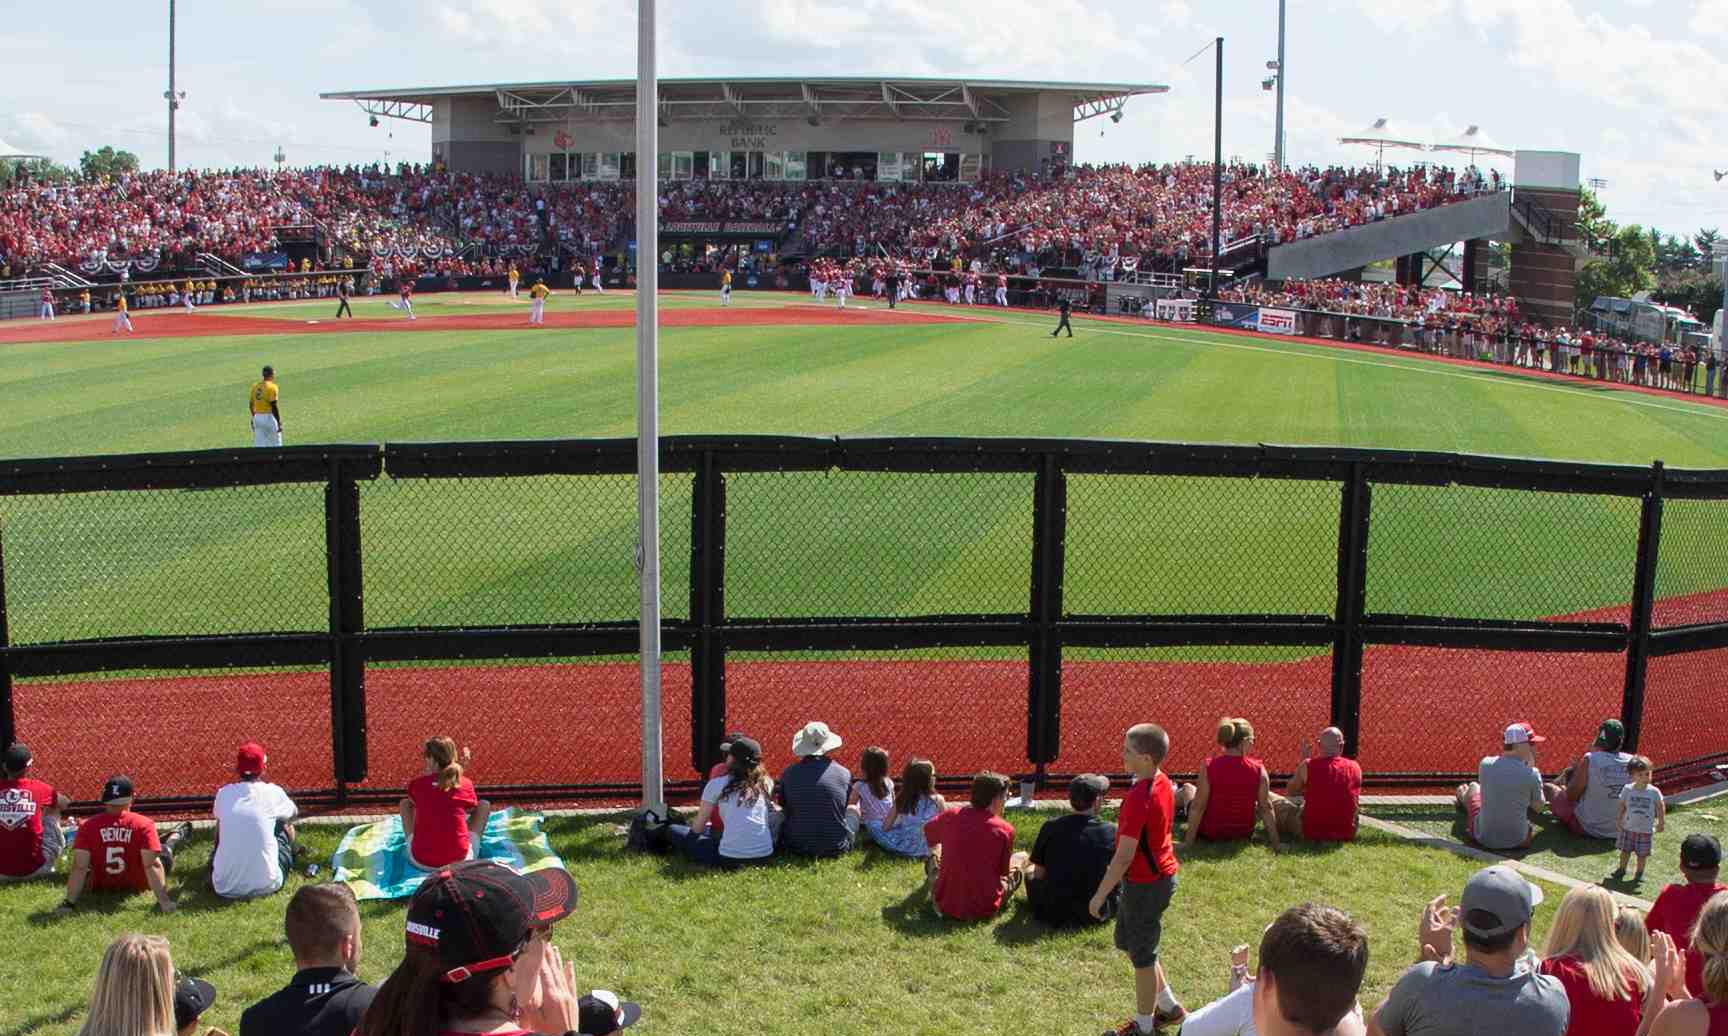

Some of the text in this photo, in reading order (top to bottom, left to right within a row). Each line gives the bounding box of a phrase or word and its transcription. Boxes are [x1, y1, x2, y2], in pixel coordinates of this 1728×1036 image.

[731, 135, 767, 149] BANK
[1260, 313, 1293, 329] ESPN
[100, 827, 132, 843] BENCH
[105, 847, 125, 875] 5
